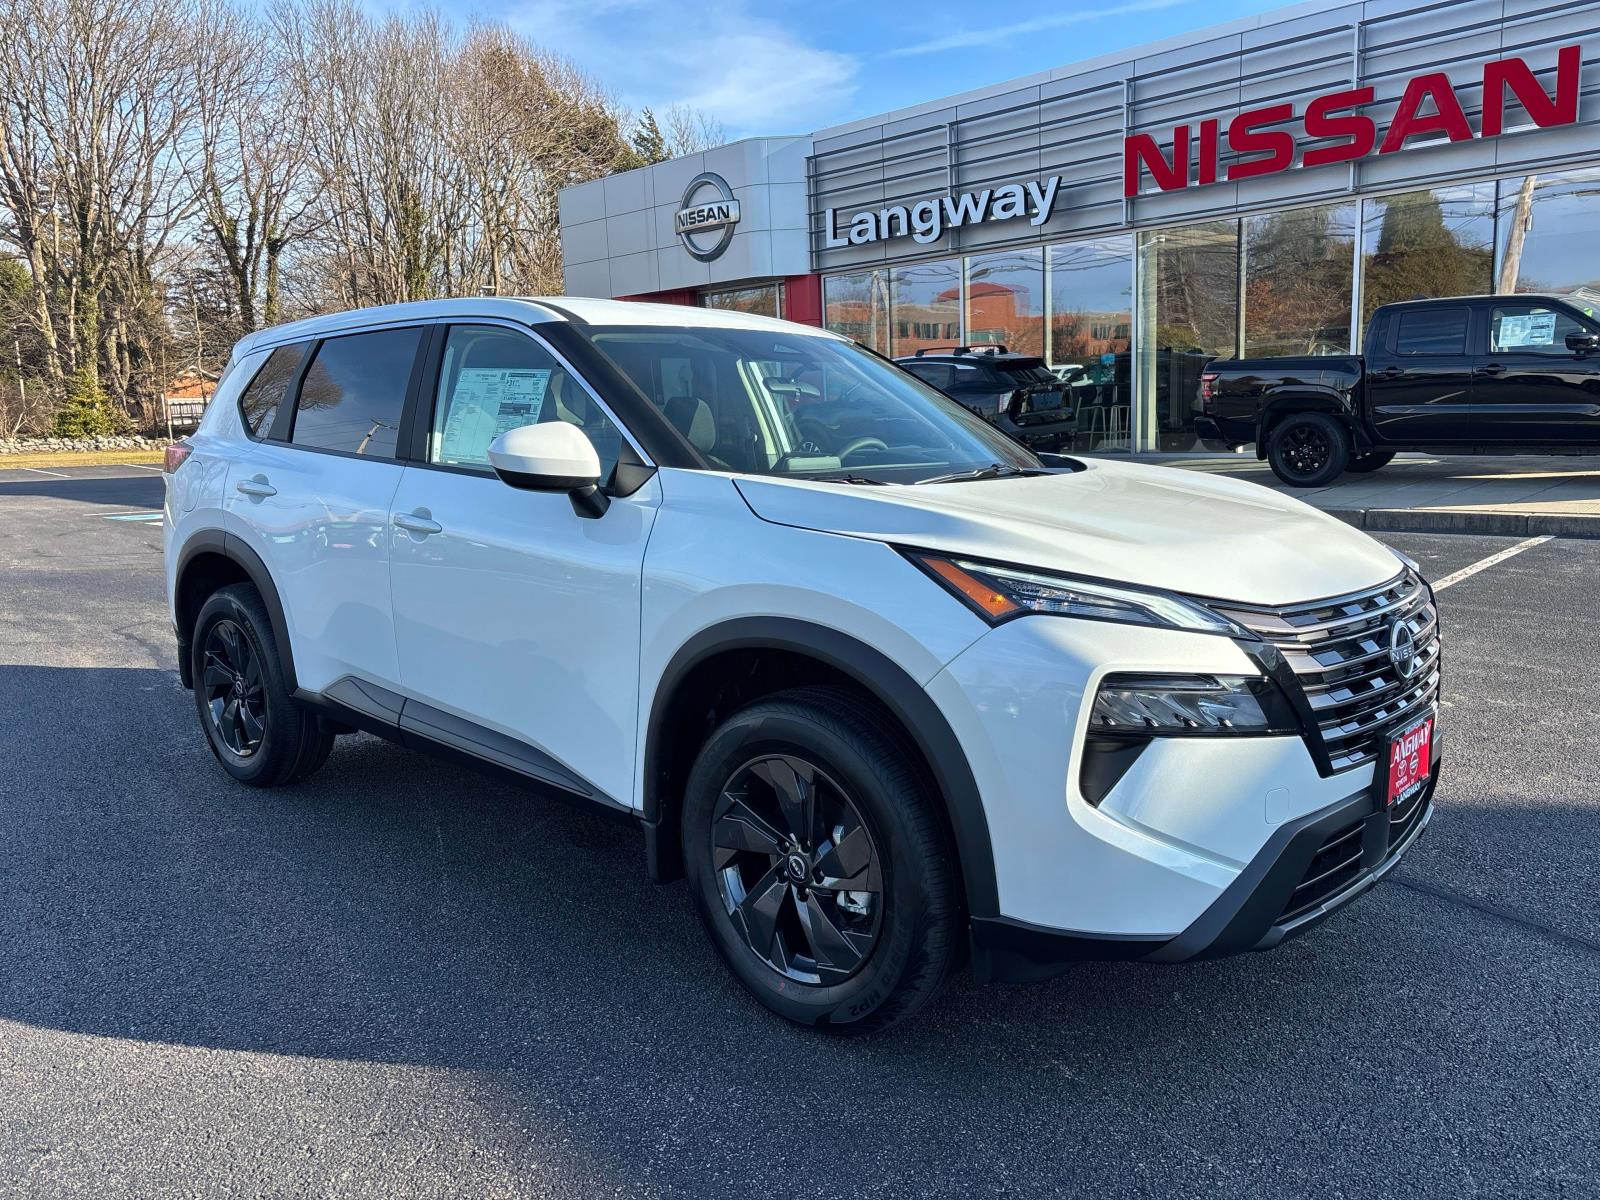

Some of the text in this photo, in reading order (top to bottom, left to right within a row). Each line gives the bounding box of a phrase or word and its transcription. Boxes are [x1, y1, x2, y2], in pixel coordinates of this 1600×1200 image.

[1124, 45, 1583, 198] NISSAN
[678, 204, 730, 228] NISSAN
[824, 175, 1062, 249] Langway
